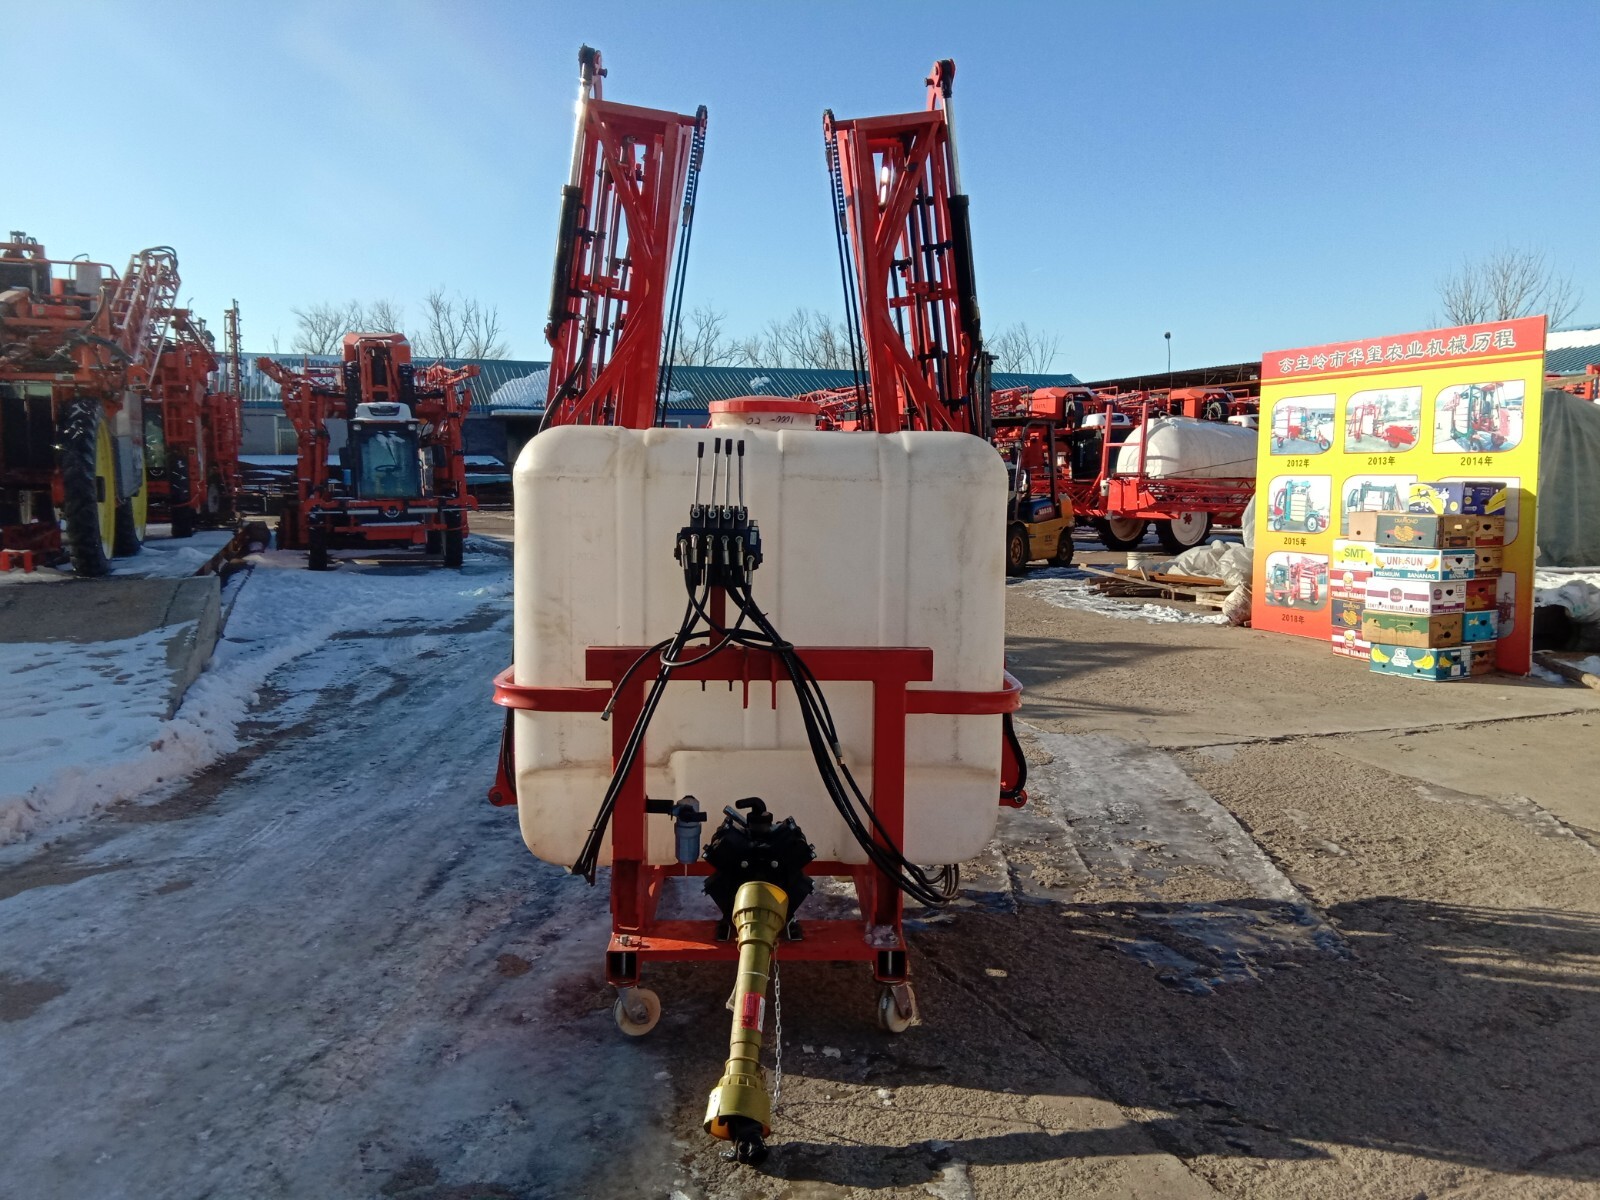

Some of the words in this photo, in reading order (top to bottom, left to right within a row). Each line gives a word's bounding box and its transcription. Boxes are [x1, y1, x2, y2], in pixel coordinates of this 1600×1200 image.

[1278, 329, 1516, 373] 公主岭市华玺农业机械历程
[1286, 458, 1310, 468] 2012年
[1367, 456, 1396, 466] 2013年
[1460, 455, 1493, 467] 2014年
[1283, 537, 1307, 547] 2015年
[1344, 547, 1365, 559] SMT
[1407, 572, 1435, 580] BANANAS
[1281, 613, 1305, 624] 2018年
